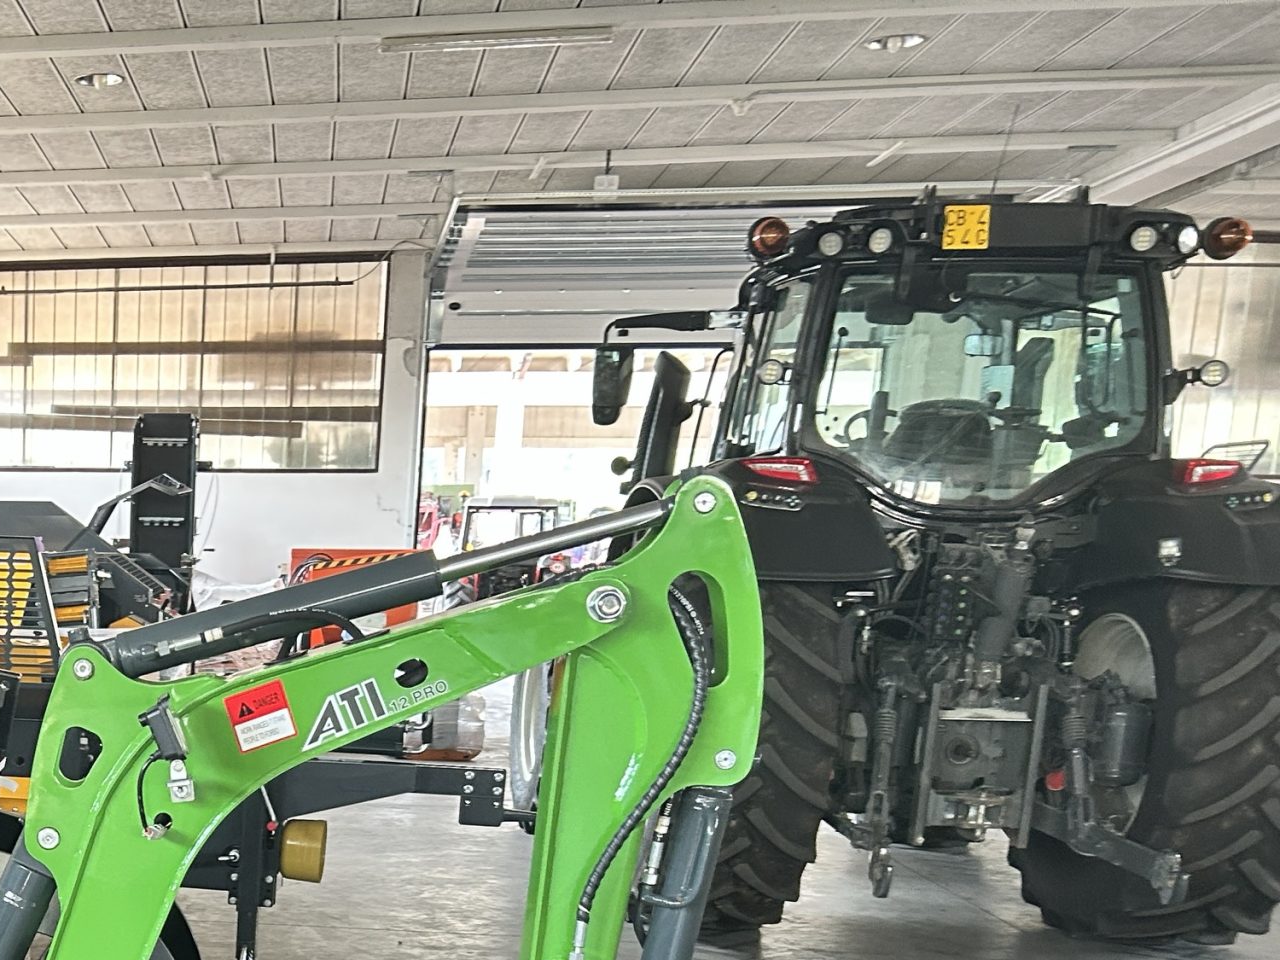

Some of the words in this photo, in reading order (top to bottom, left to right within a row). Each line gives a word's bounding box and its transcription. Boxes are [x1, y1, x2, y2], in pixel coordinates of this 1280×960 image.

[304, 678, 388, 751] ATI
[390, 696, 410, 712] 12
[411, 680, 448, 703] PRO
